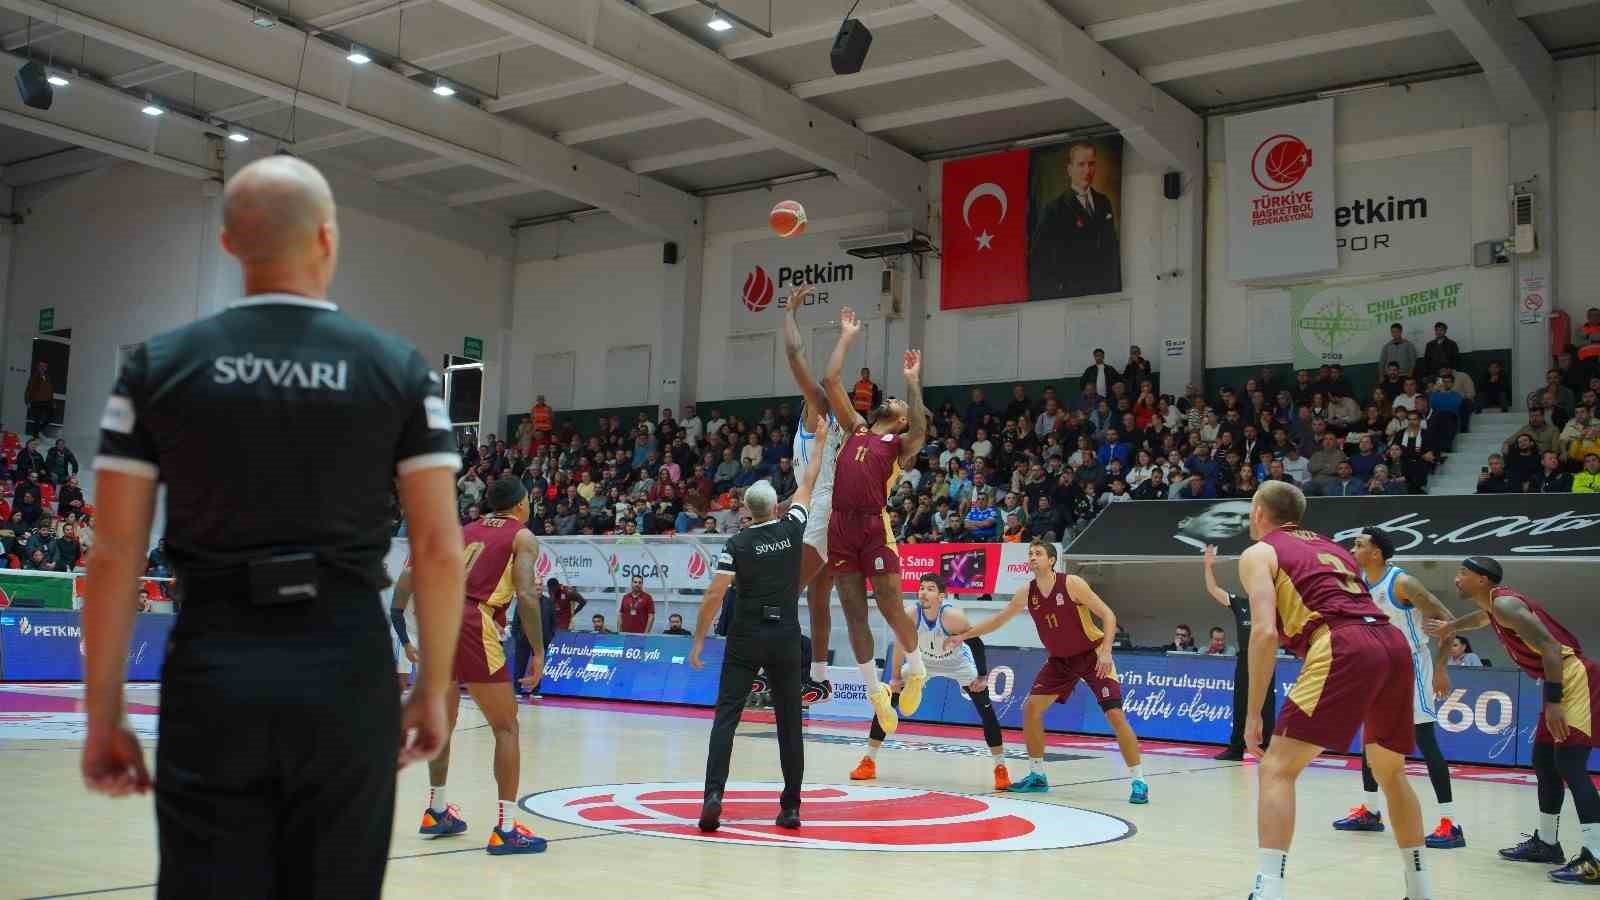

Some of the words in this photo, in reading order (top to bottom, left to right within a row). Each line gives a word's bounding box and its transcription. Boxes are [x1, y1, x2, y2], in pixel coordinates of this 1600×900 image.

[1252, 190, 1313, 210] TÜRKİYE
[1252, 203, 1313, 219] BASKETBOL
[1335, 195, 1427, 227] etkim
[1336, 234, 1390, 251] POR
[778, 261, 854, 289] Petkim
[777, 291, 830, 309] SOR
[1367, 288, 1440, 315] CHILDREN
[1443, 282, 1465, 298] OF
[1376, 309, 1403, 324] THE
[1407, 297, 1457, 317] NORTH
[854, 446, 870, 463] 11
[906, 555, 935, 567] Sana
[621, 564, 669, 579] SOCAR
[901, 569, 929, 581] imu
[1316, 552, 1362, 595] 3
[1045, 613, 1059, 629] 11
[987, 665, 1015, 703] 0
[1119, 671, 1142, 685] n'in
[1146, 672, 1235, 691] kuruluşunu
[1122, 688, 1176, 721] kutlu
[1176, 691, 1234, 727] olsun
[1437, 688, 1513, 735] 60
